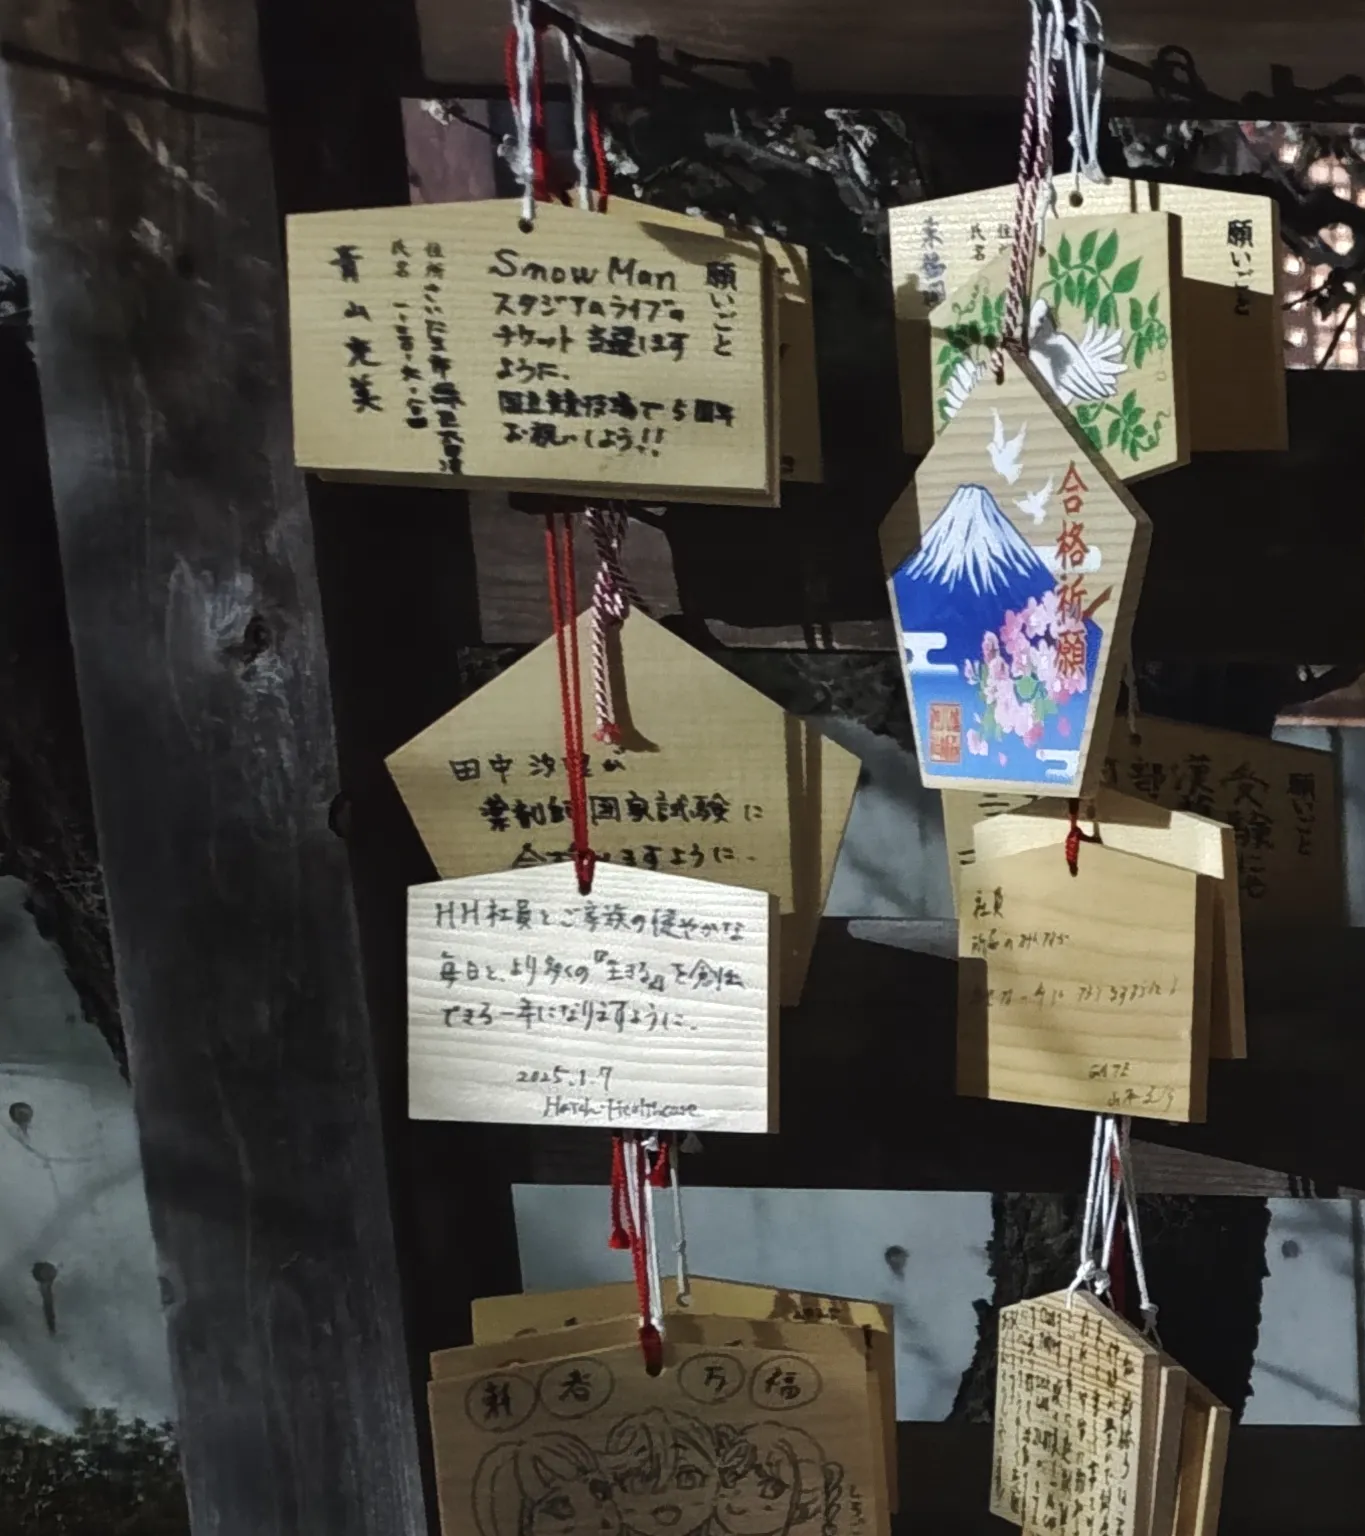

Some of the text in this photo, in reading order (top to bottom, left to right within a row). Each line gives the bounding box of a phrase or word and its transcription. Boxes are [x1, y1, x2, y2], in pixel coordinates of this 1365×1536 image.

[487, 248, 599, 286] Snow
[705, 261, 738, 358] 願いごと
[1227, 218, 1255, 316] 願いごと
[1055, 460, 1090, 677] 合格祈願
[449, 753, 514, 784] 田中
